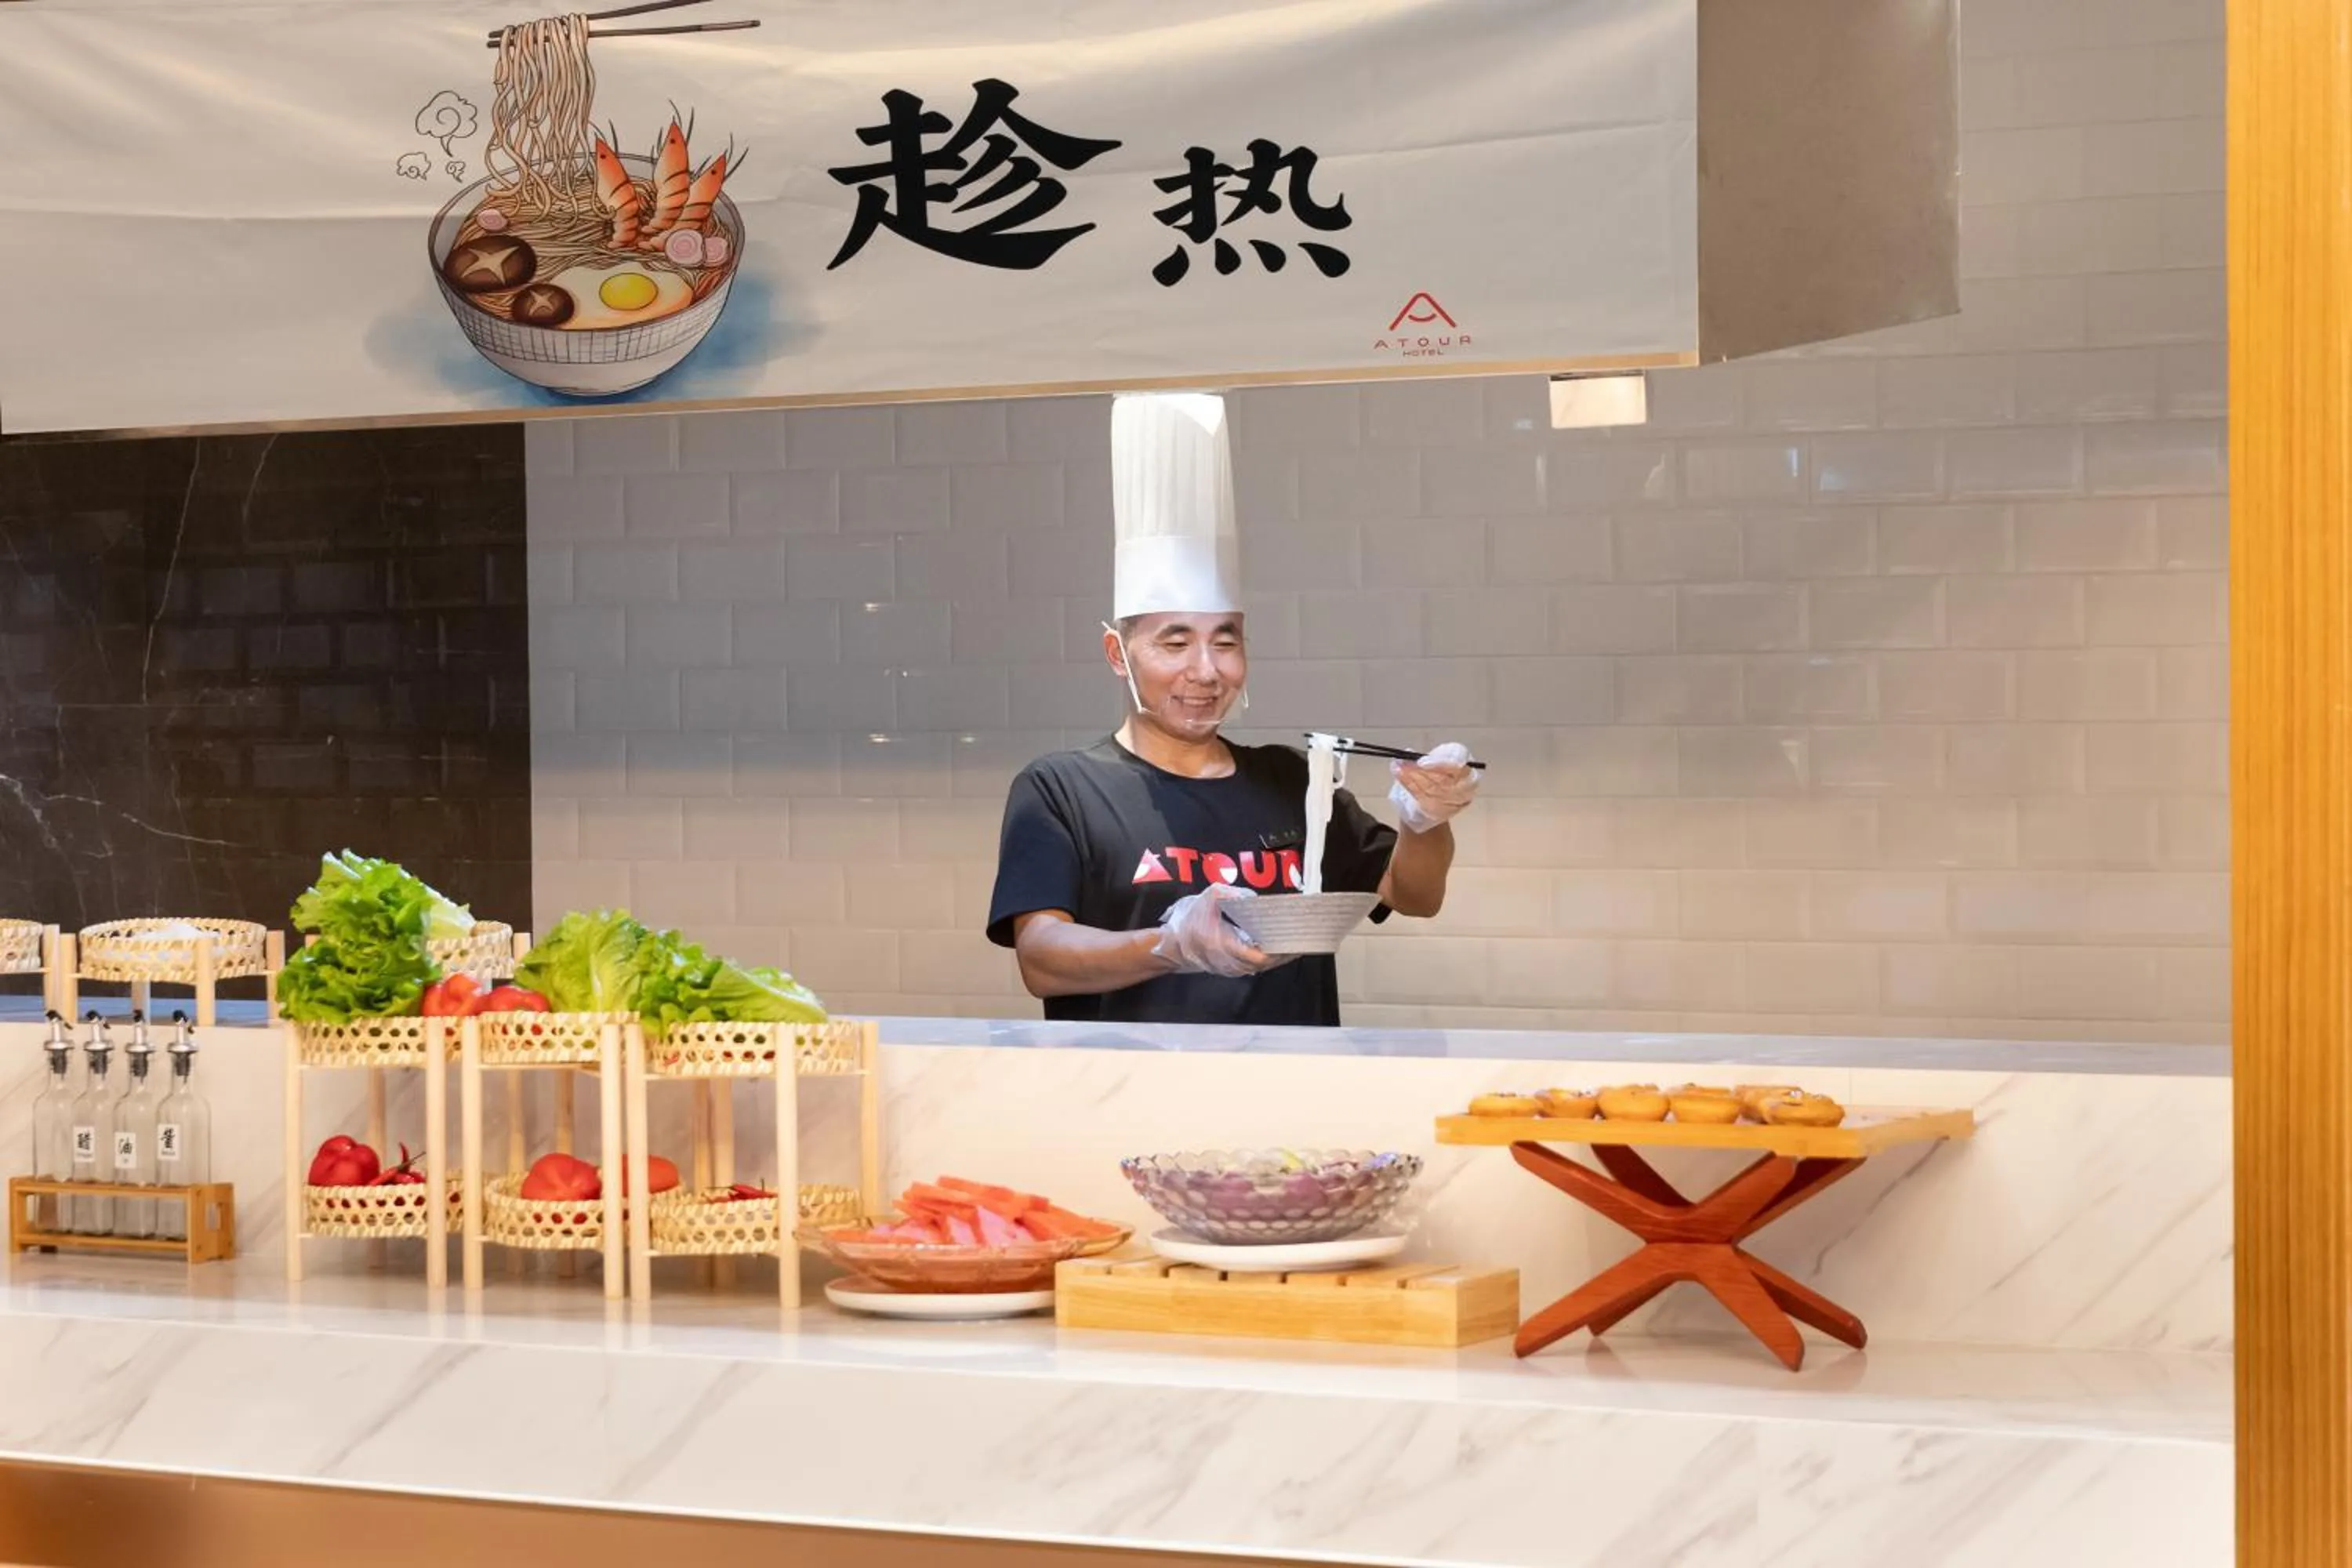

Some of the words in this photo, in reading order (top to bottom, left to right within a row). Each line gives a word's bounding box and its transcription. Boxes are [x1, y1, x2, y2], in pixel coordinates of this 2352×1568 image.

[827, 78, 1352, 287] 趁热
[1374, 335, 1472, 350] ATOUR
[1403, 349, 1444, 358] HOTEL
[118, 1136, 132, 1155] 油
